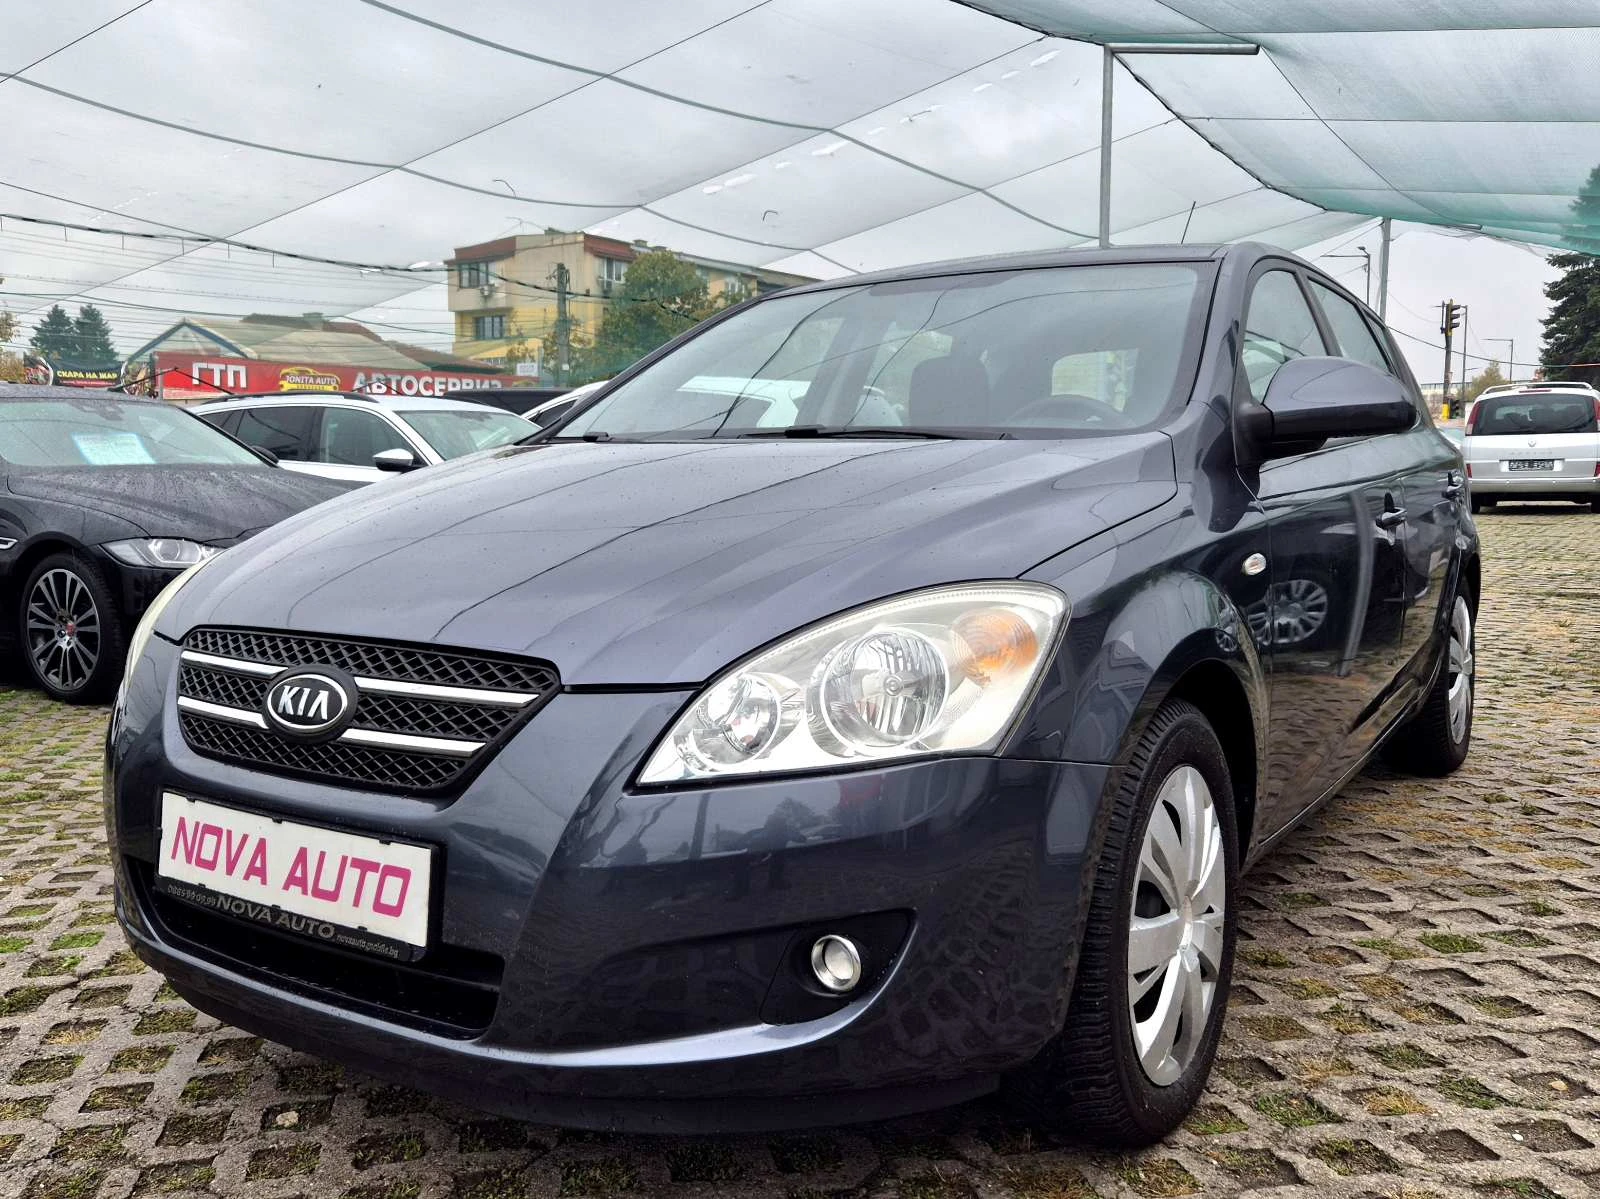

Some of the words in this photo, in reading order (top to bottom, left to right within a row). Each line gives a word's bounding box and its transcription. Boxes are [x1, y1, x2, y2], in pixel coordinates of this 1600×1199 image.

[57, 370, 84, 379] СКАРА
[192, 362, 247, 388] ГТП
[315, 376, 337, 385] AUTO
[277, 685, 329, 720] KIA
[170, 816, 268, 886] NOVA
[281, 846, 412, 918] AUTO
[216, 895, 272, 923] NOVA
[275, 913, 336, 939] AUTO
